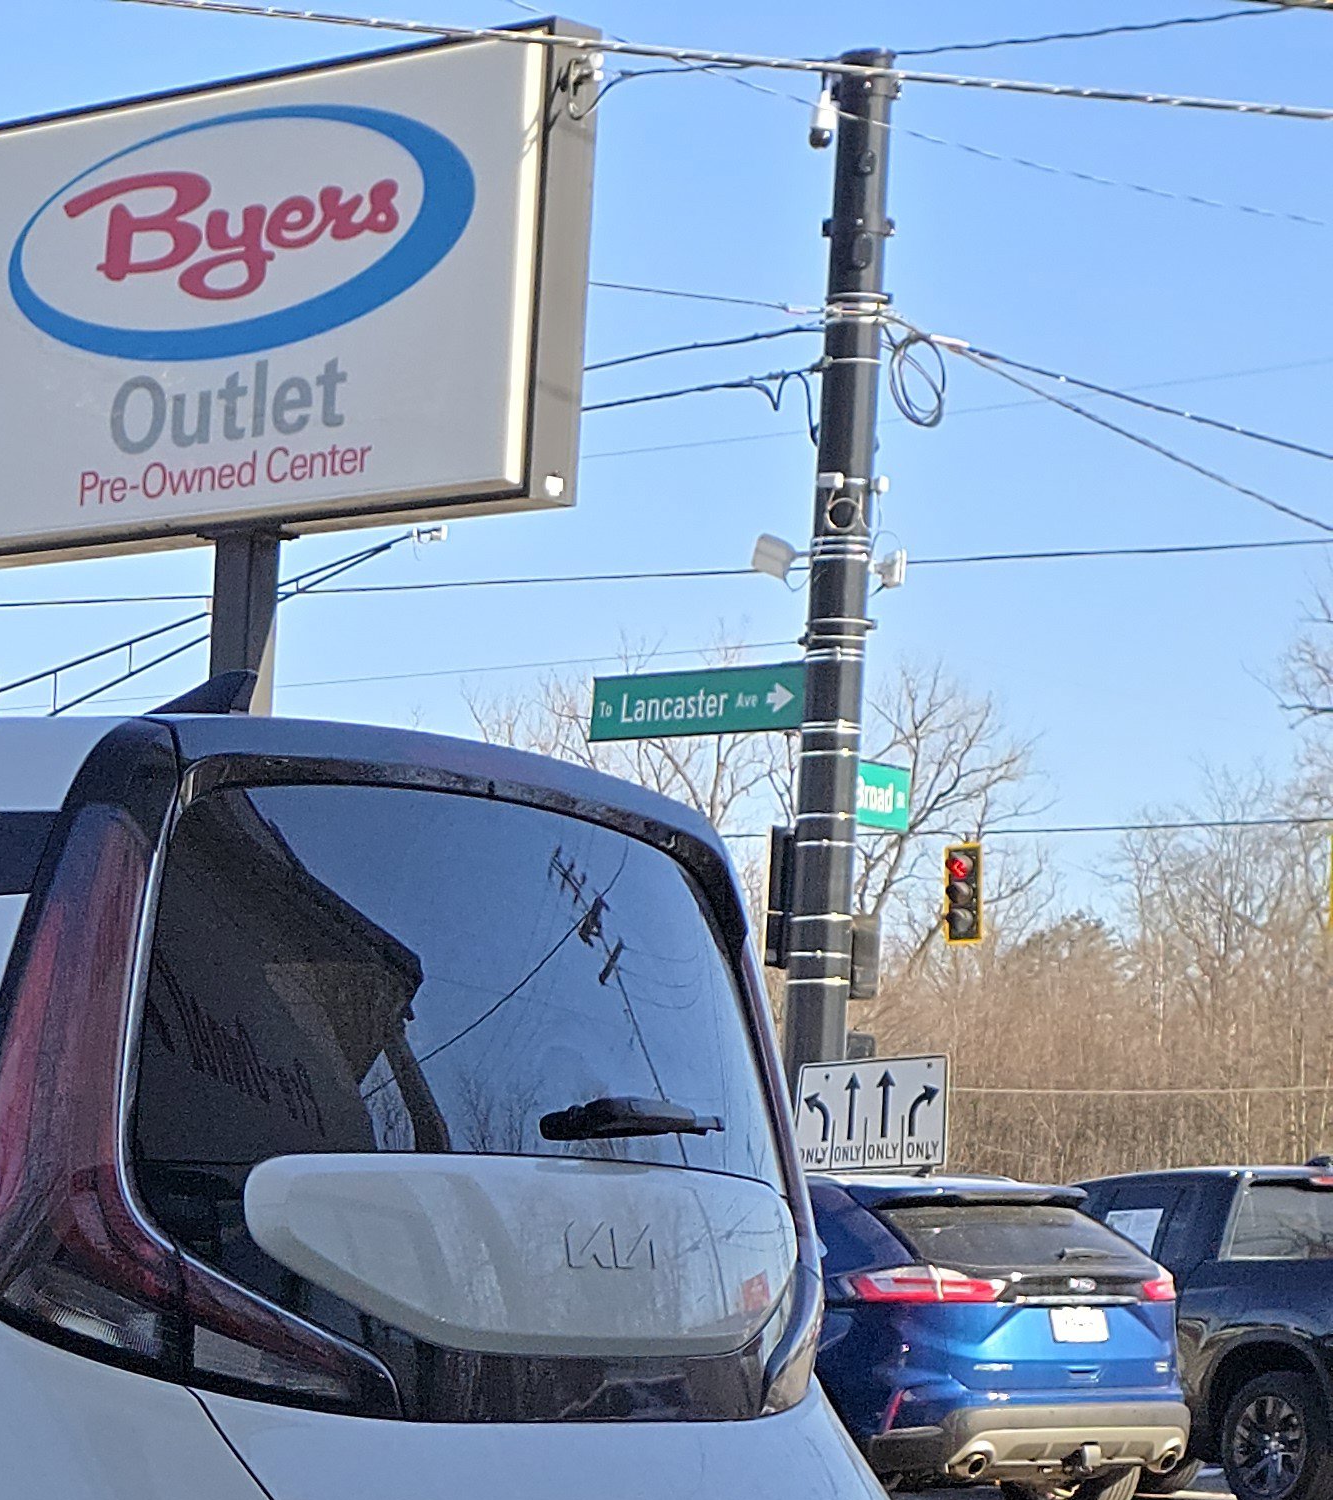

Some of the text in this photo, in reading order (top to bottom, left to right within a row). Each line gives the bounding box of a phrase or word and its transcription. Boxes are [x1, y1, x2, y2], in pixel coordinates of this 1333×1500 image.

[64, 171, 399, 301] Byers
[110, 357, 348, 455] Outlet
[79, 443, 373, 506] Pre-Owned Center
[599, 688, 759, 723] To Lancaster Ave
[833, 1145, 863, 1162] ONLY
[867, 1142, 900, 1160] ONLY
[906, 1140, 940, 1159] ONLY
